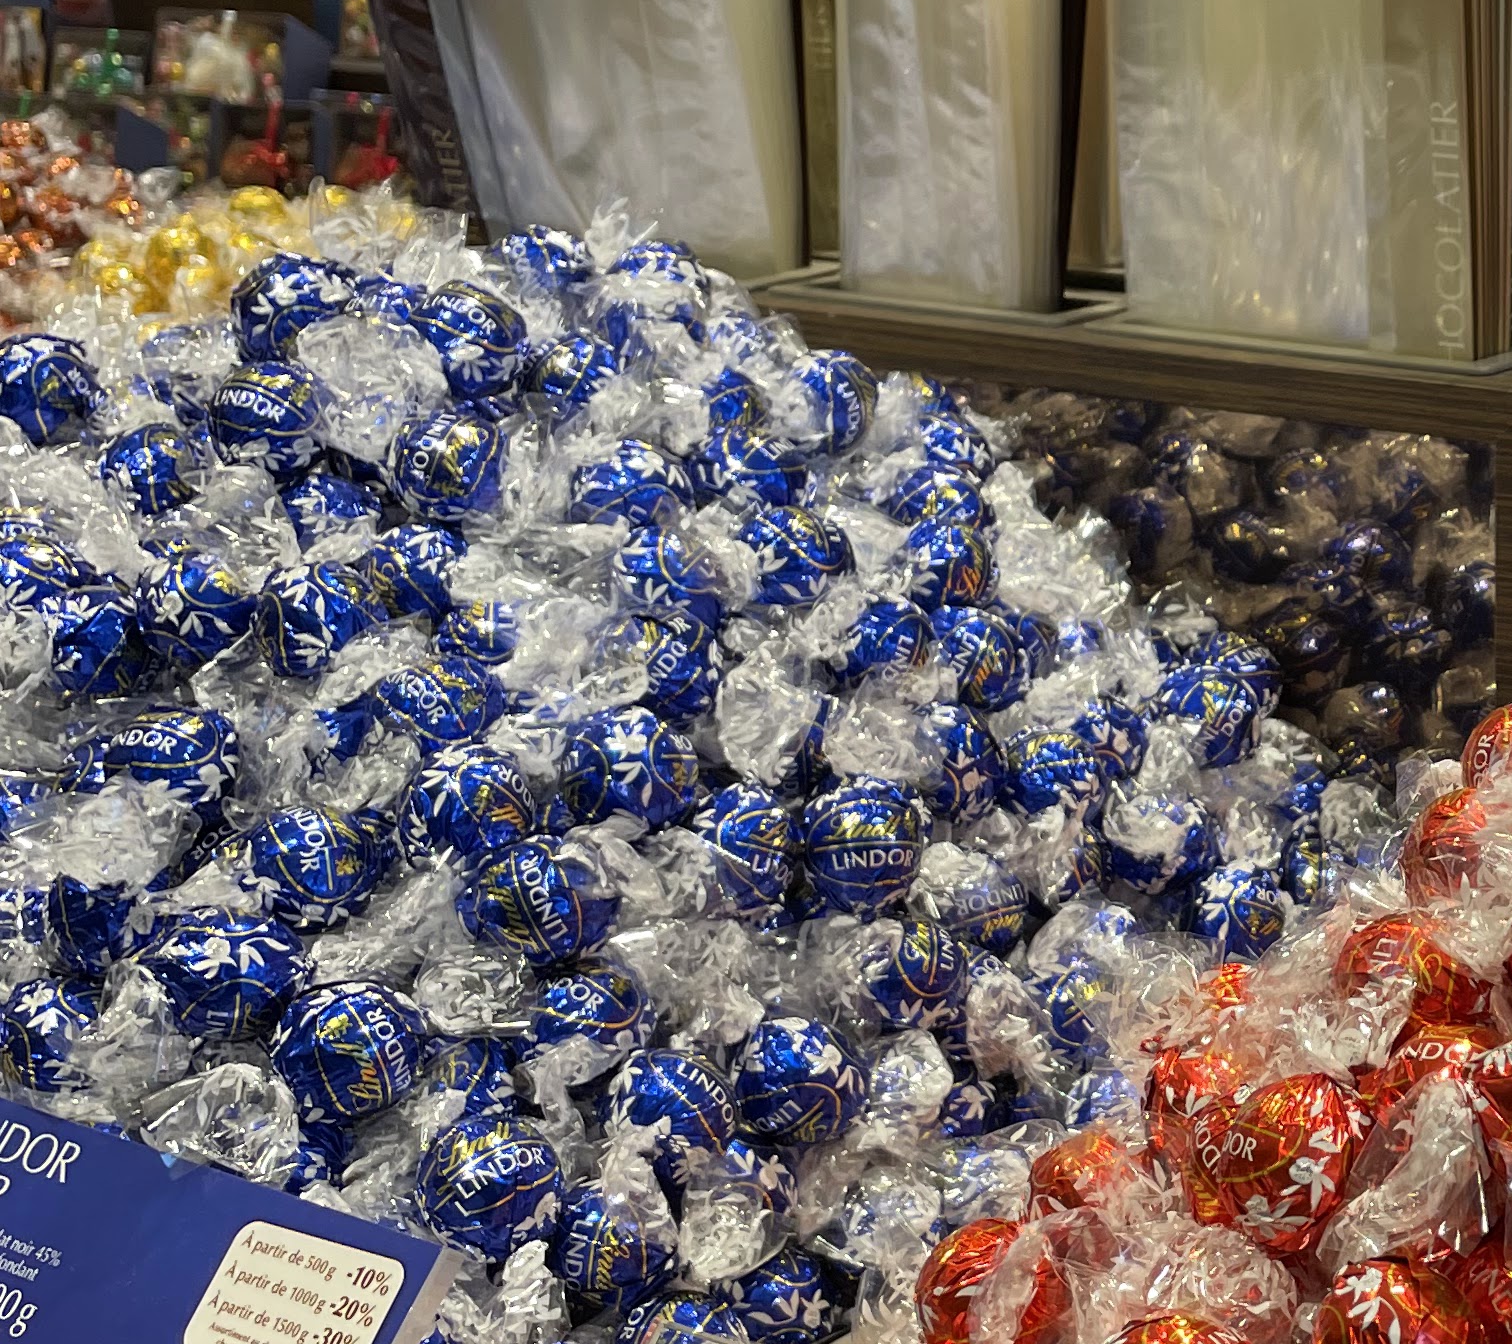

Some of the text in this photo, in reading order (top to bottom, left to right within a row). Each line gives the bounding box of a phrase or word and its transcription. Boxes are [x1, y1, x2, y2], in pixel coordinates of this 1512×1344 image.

[832, 850, 915, 872] LINDOR
[455, 1149, 543, 1199] LINDOR
[10, 1239, 62, 1267] noir 45%
[241, 1230, 254, 1248] À
[252, 1237, 288, 1261] partir
[288, 1250, 304, 1266] de
[347, 1265, 392, 1296] -10%
[208, 1290, 221, 1307] À
[218, 1299, 254, 1322] partir
[254, 1310, 270, 1327] de
[225, 1260, 238, 1278] À
[234, 1268, 271, 1291] partir
[271, 1280, 288, 1296] de
[330, 1295, 376, 1328] -20%
